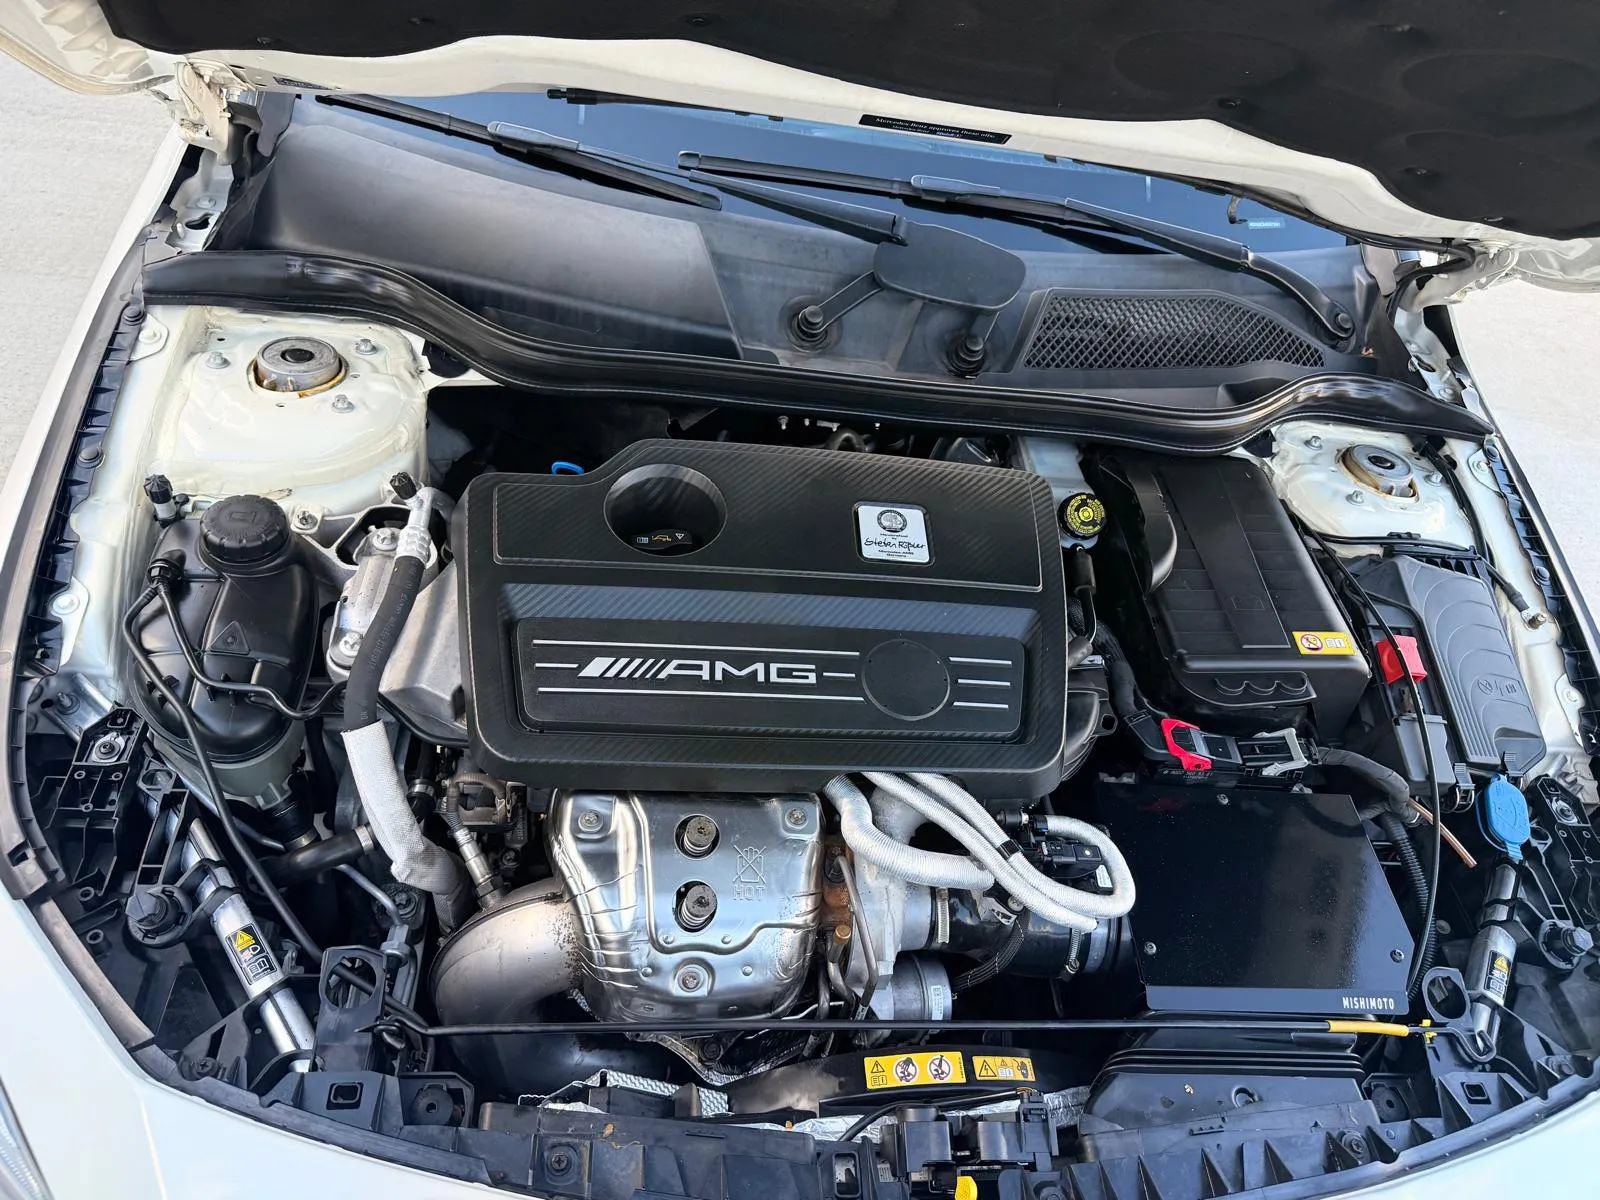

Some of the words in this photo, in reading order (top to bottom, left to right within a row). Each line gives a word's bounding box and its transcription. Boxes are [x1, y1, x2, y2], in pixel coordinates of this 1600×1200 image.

[655, 658, 817, 684] AMG
[733, 885, 766, 901] HOT
[1342, 996, 1395, 1010] MISHIMOTO
